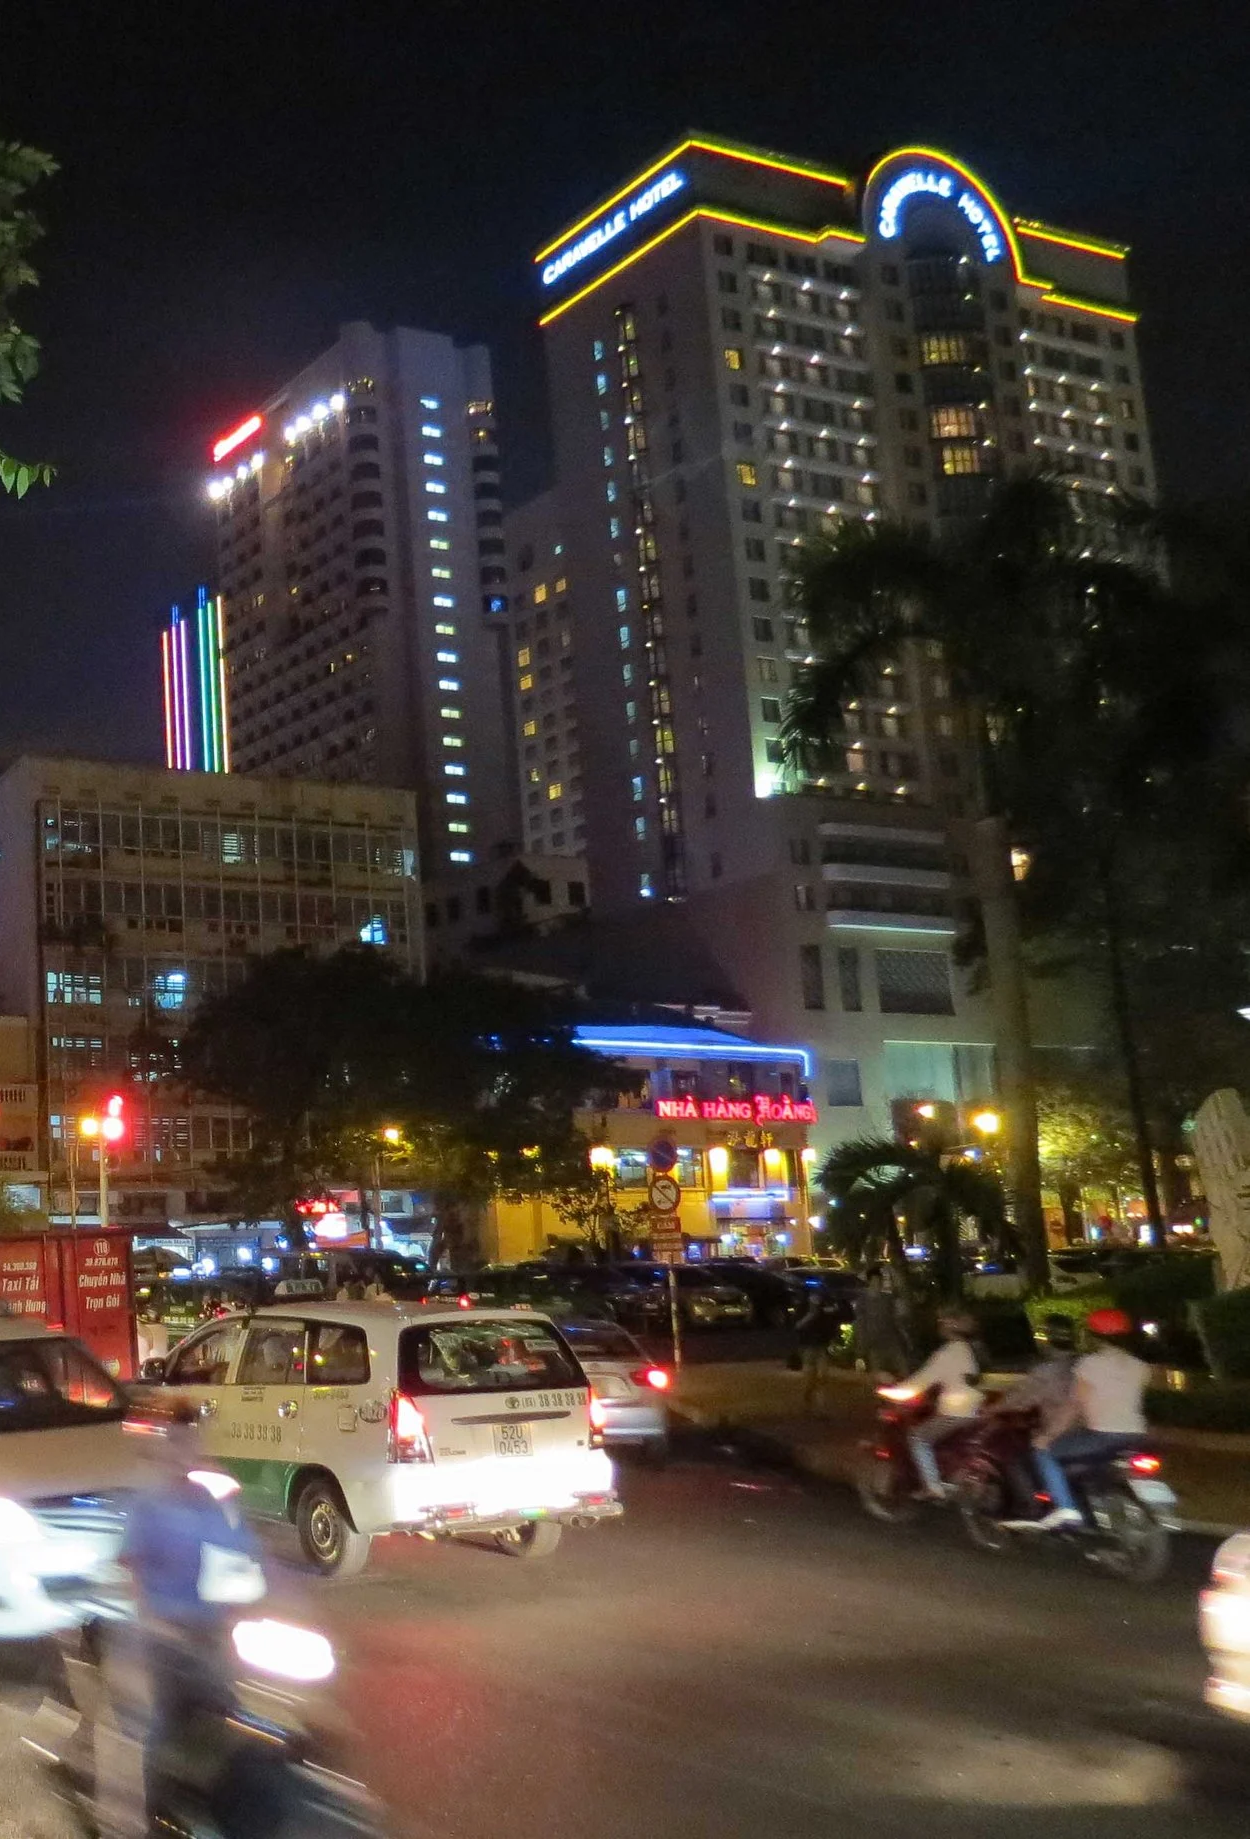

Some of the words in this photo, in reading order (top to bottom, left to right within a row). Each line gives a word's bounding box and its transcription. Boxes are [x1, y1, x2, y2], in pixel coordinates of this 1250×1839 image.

[878, 172, 951, 238] CARAVELLE
[957, 192, 1001, 262] HOTEL
[542, 210, 626, 285] CARAVELLE
[629, 172, 684, 221] HOTEL
[657, 1094, 698, 1118] NHÀ
[702, 1096, 752, 1119] HÀNG
[2, 1277, 23, 1292] Taxi
[501, 1425, 524, 1440] 52U
[499, 1440, 529, 1456] 0453
